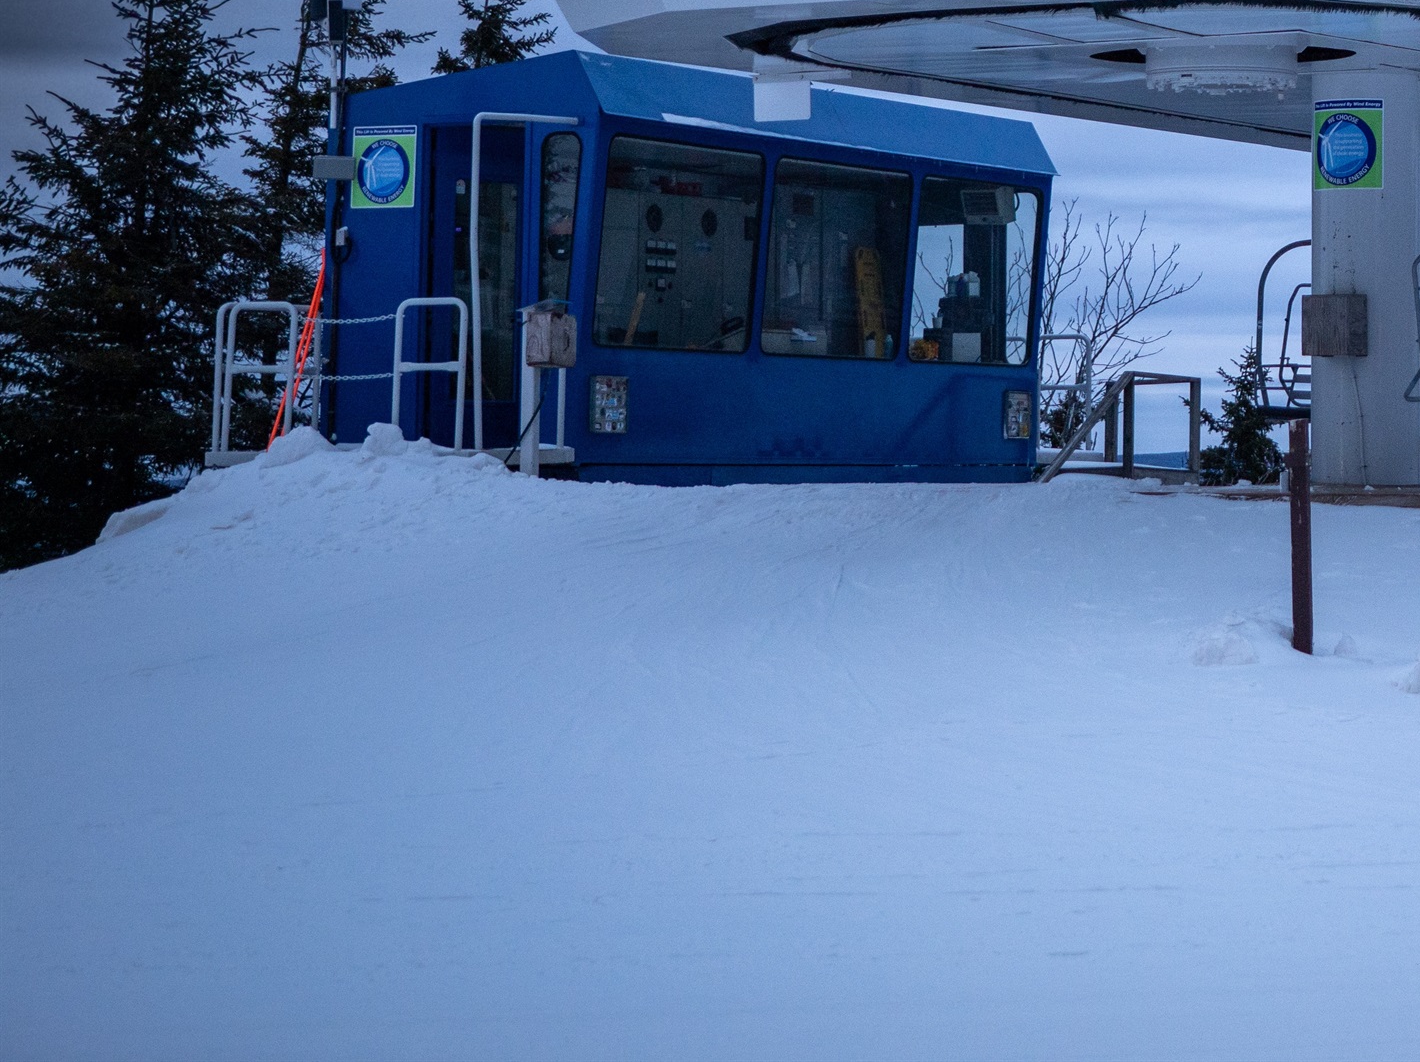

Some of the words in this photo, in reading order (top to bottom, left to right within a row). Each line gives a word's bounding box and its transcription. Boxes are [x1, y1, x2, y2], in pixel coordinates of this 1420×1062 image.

[1327, 115, 1335, 124] WE
[1335, 114, 1359, 125] CHOOSE
[380, 140, 398, 149] CHOOSE
[1320, 165, 1347, 185] RENEWABLE
[1348, 163, 1370, 183] ENERGY
[387, 184, 405, 202] ENERGY
